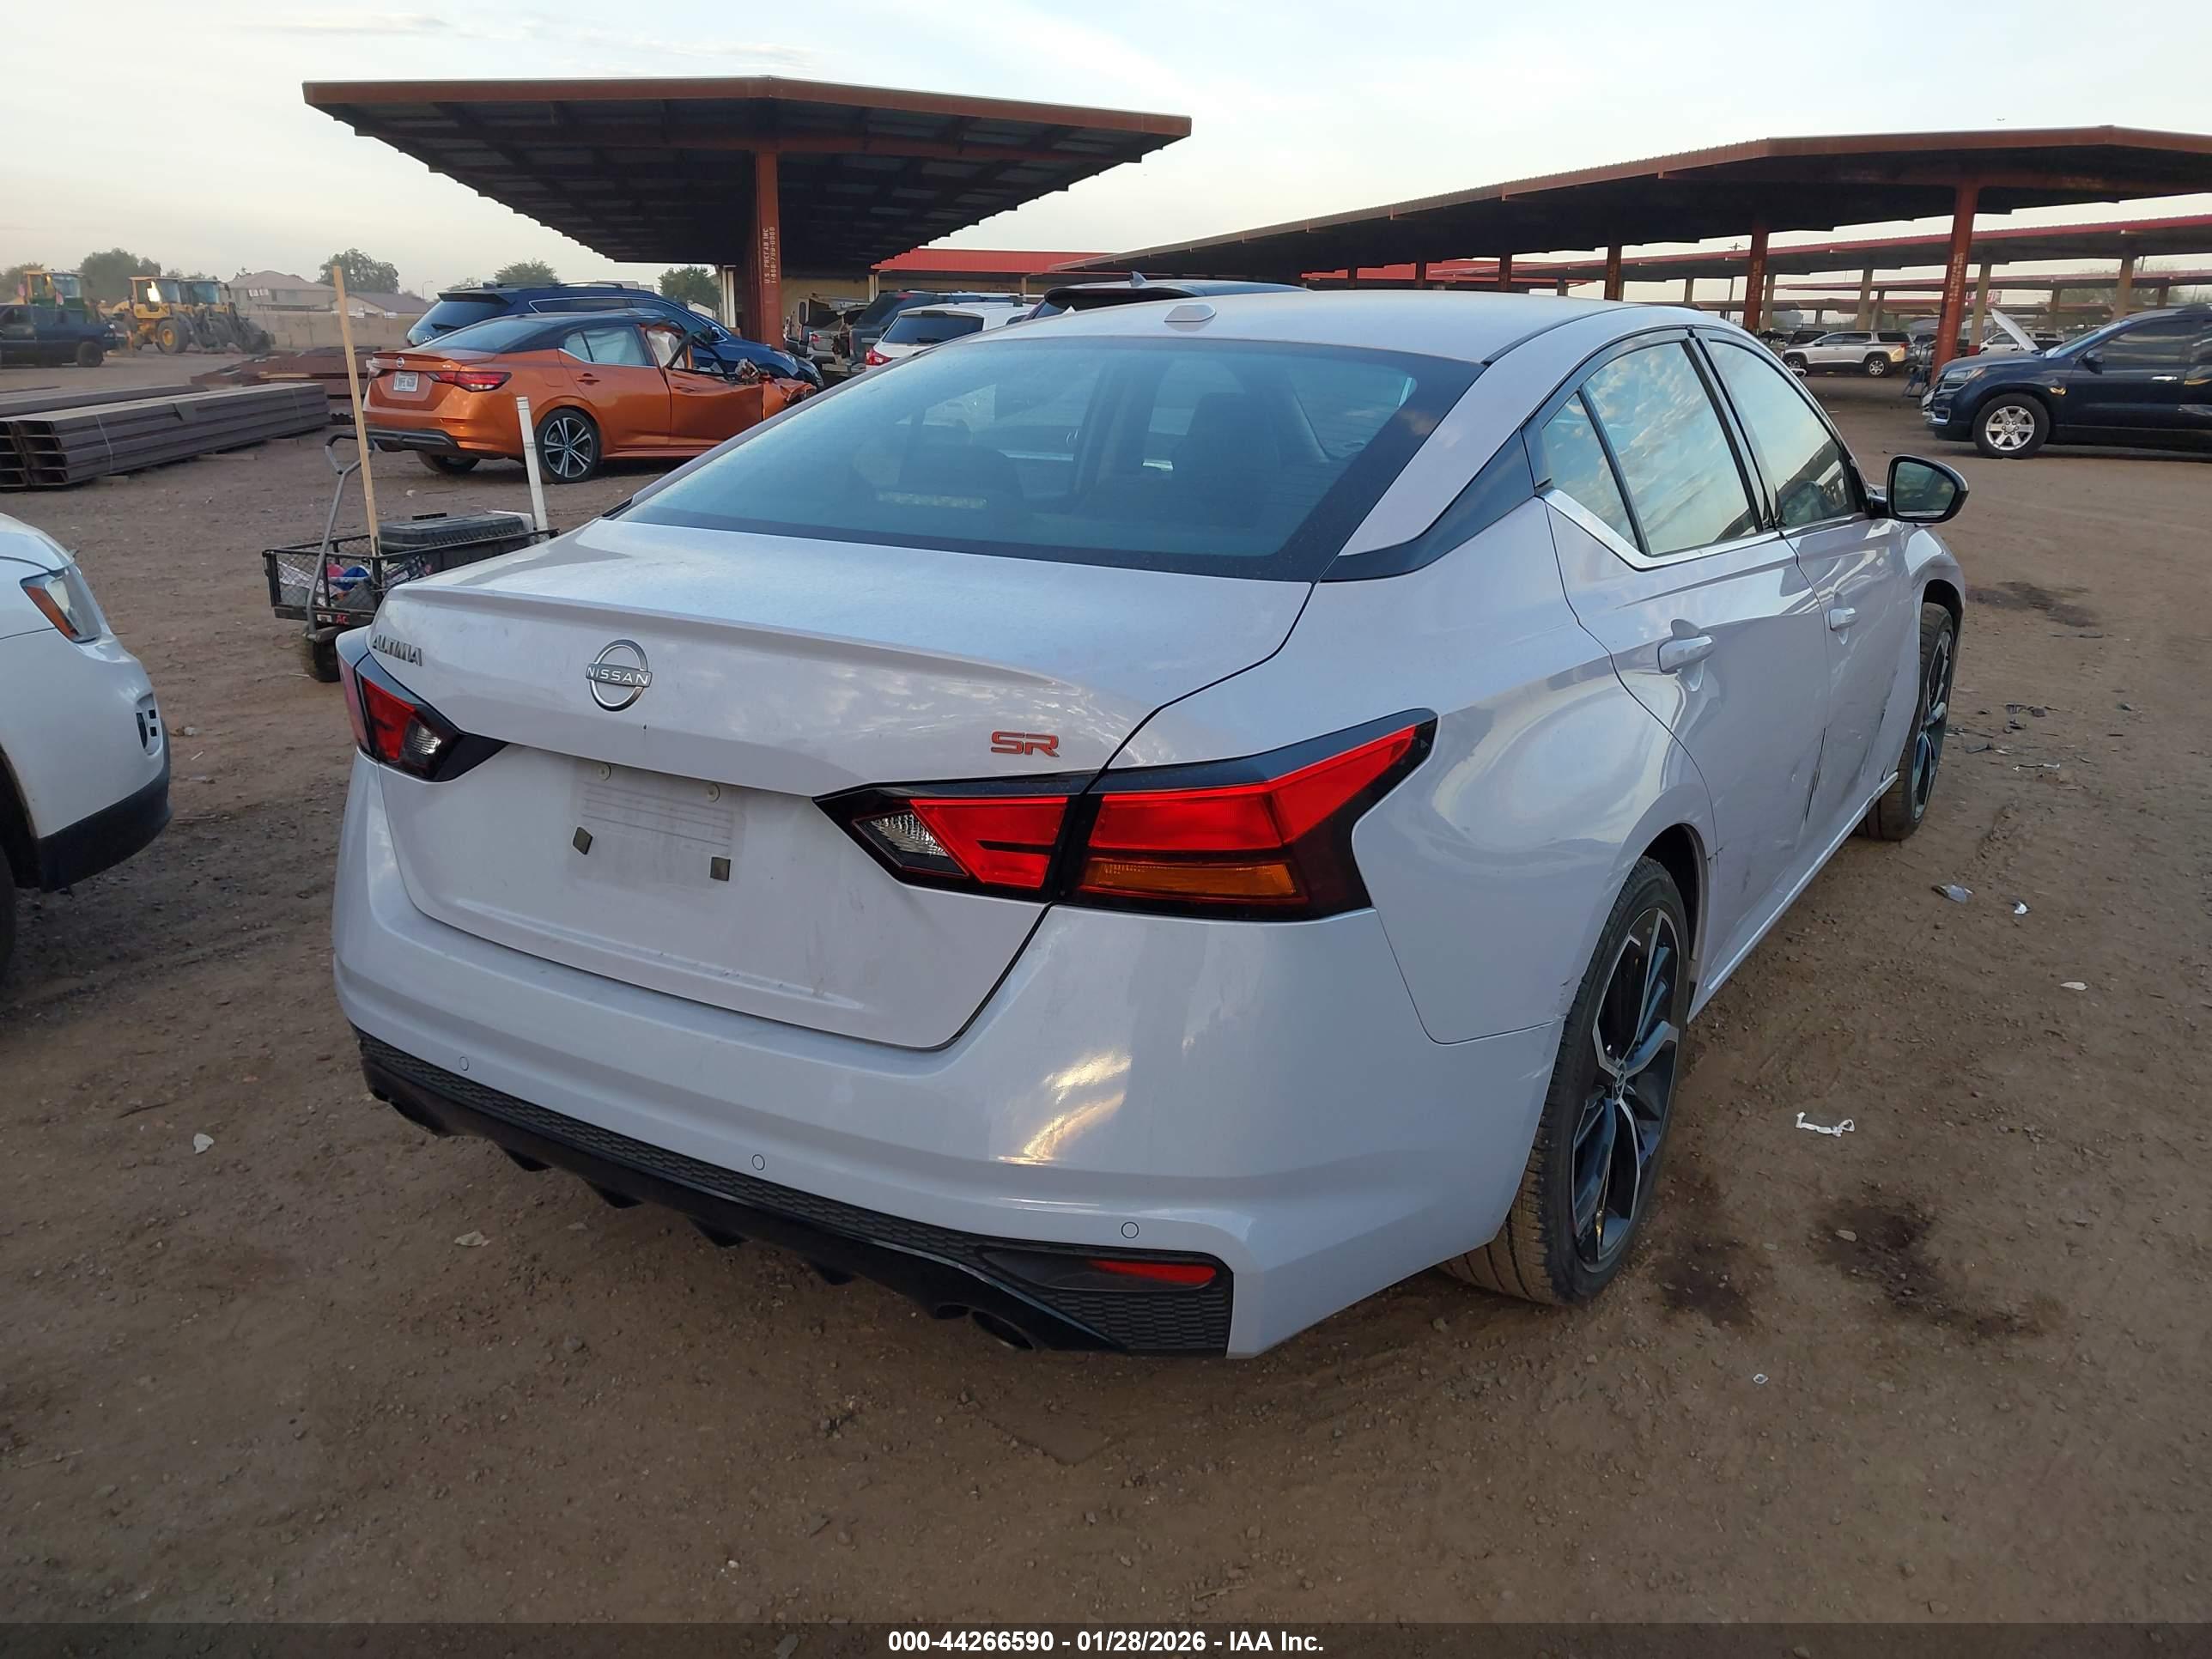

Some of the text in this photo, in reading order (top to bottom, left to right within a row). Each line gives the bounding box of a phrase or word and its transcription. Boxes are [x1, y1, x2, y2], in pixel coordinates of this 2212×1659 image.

[372, 634, 422, 667] ALTIMA
[586, 666, 648, 684] NISSAN
[990, 731, 1060, 757] SR
